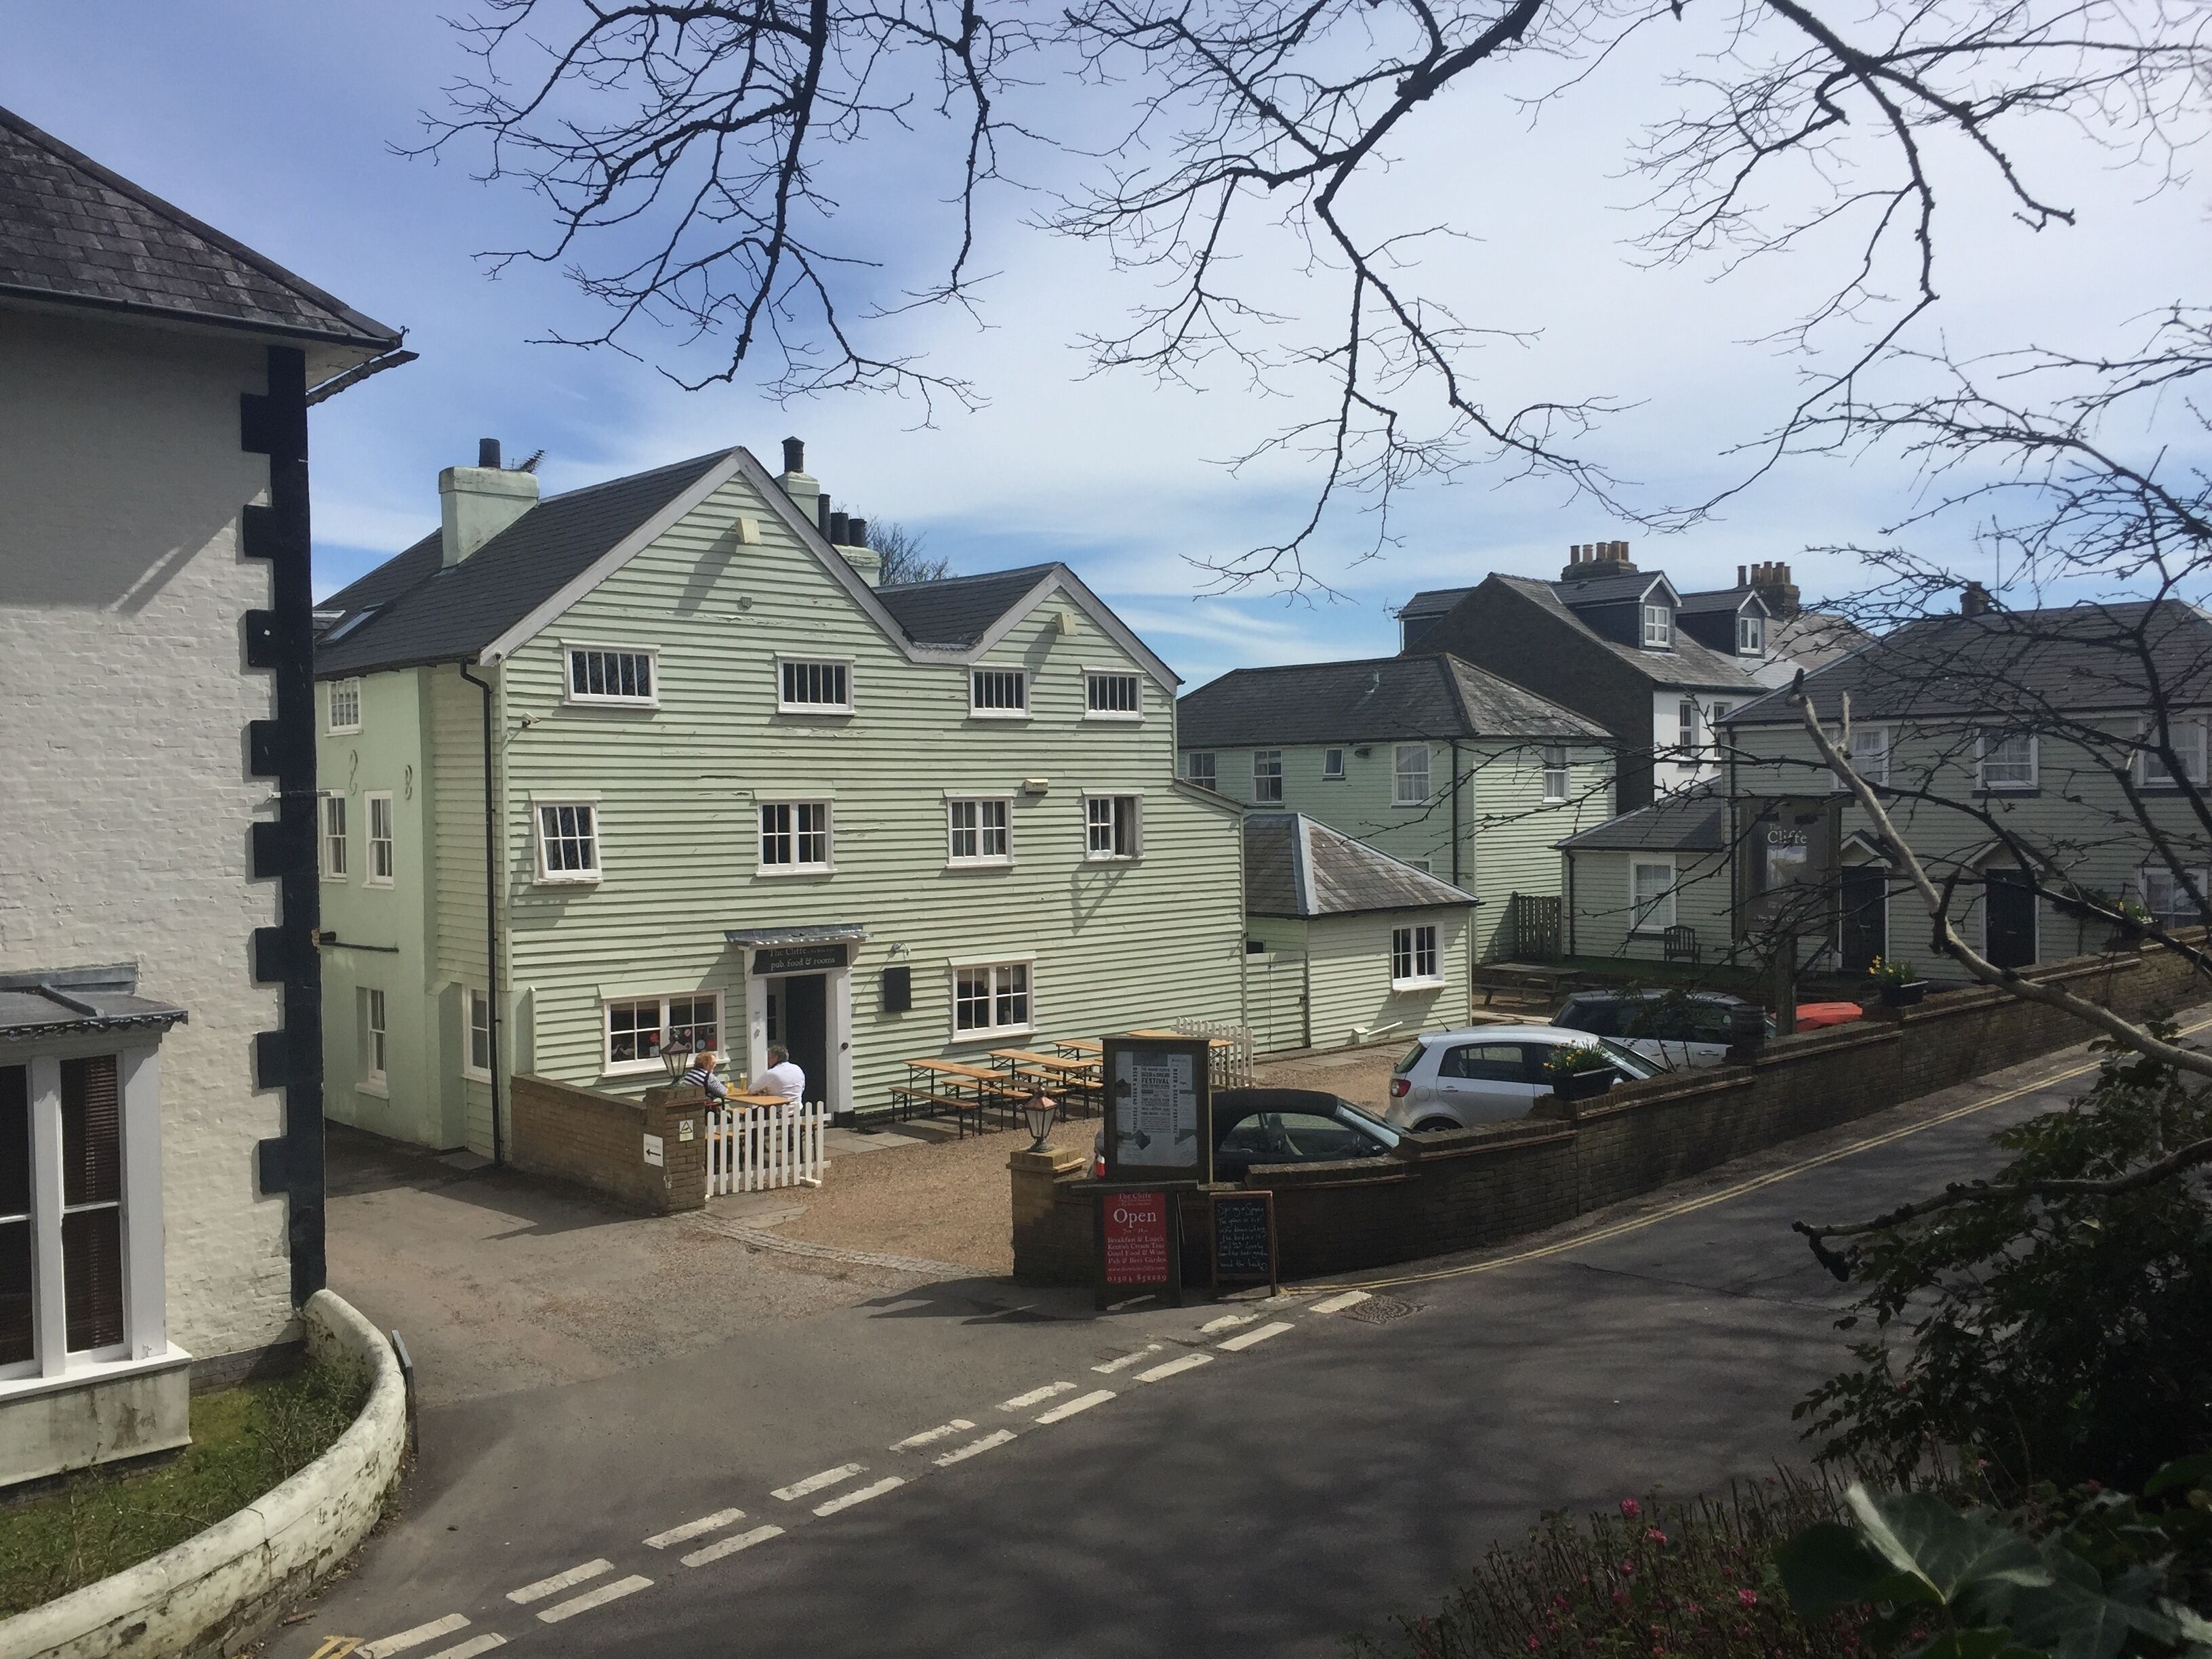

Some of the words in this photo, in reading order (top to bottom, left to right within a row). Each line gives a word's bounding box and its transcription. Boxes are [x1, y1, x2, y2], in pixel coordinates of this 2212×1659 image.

[1767, 830, 1808, 844] Cliffe
[769, 948, 783, 957] The
[785, 947, 807, 956] Cliffe
[787, 958, 804, 967] food
[805, 957, 812, 965] &
[1113, 1208, 1157, 1228] Open
